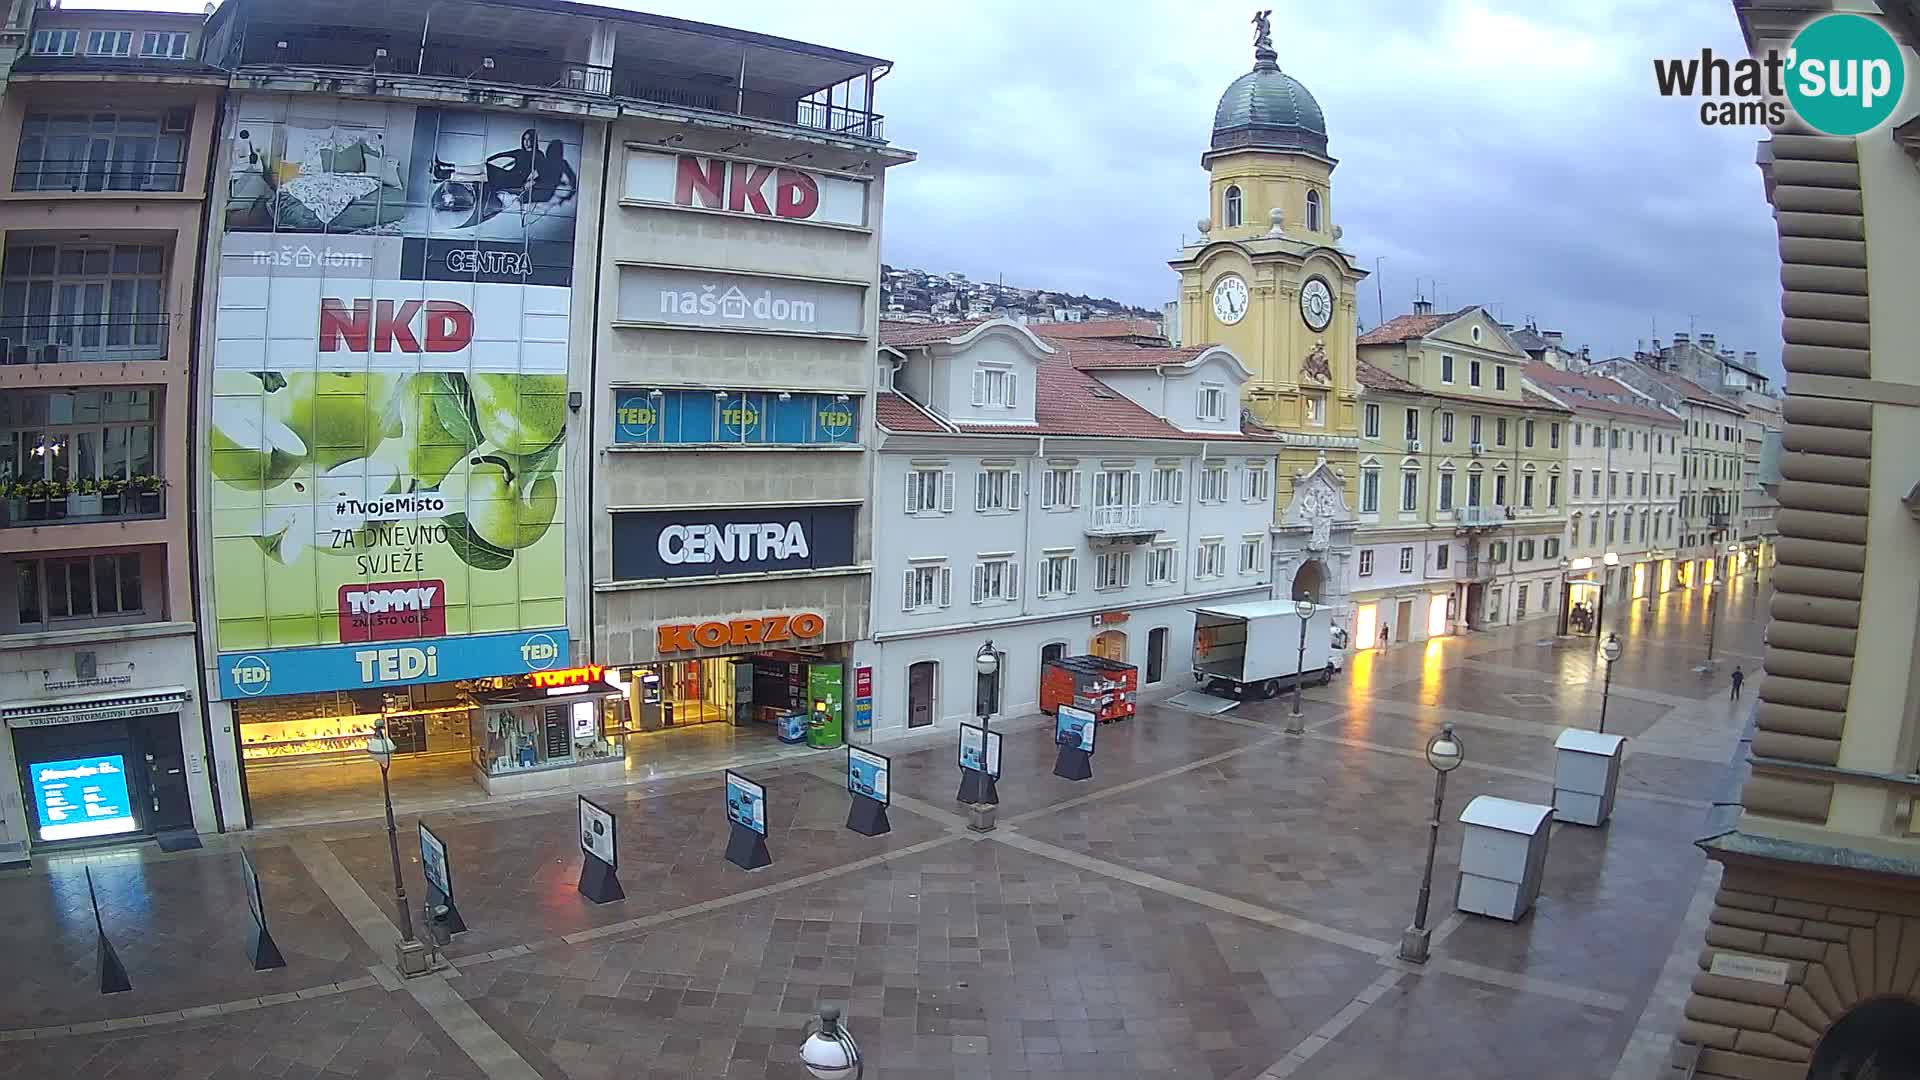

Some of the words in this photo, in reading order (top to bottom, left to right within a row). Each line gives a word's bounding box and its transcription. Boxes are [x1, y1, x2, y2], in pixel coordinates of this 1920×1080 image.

[674, 156, 819, 219] NKD
[253, 246, 293, 267] naš
[317, 247, 365, 268] dom
[446, 249, 533, 275] CENTRA
[660, 284, 716, 316] naš
[753, 290, 816, 323] dom
[318, 297, 475, 353] NKD
[617, 408, 657, 425] TEDi
[722, 409, 759, 426] TEDi
[819, 411, 852, 427] TEDi
[336, 497, 444, 517] #TvojeMisto
[331, 528, 356, 549] ZA
[365, 524, 449, 548] DNEVNO
[658, 521, 809, 565] CENTRA
[357, 547, 425, 576] SVJEŽE
[345, 586, 438, 615] TOMMY
[657, 612, 825, 653] KORZO
[355, 646, 438, 683] TEDi
[520, 643, 558, 661] TEDi
[231, 666, 271, 684] TEDi
[532, 664, 604, 688] TOMMY
